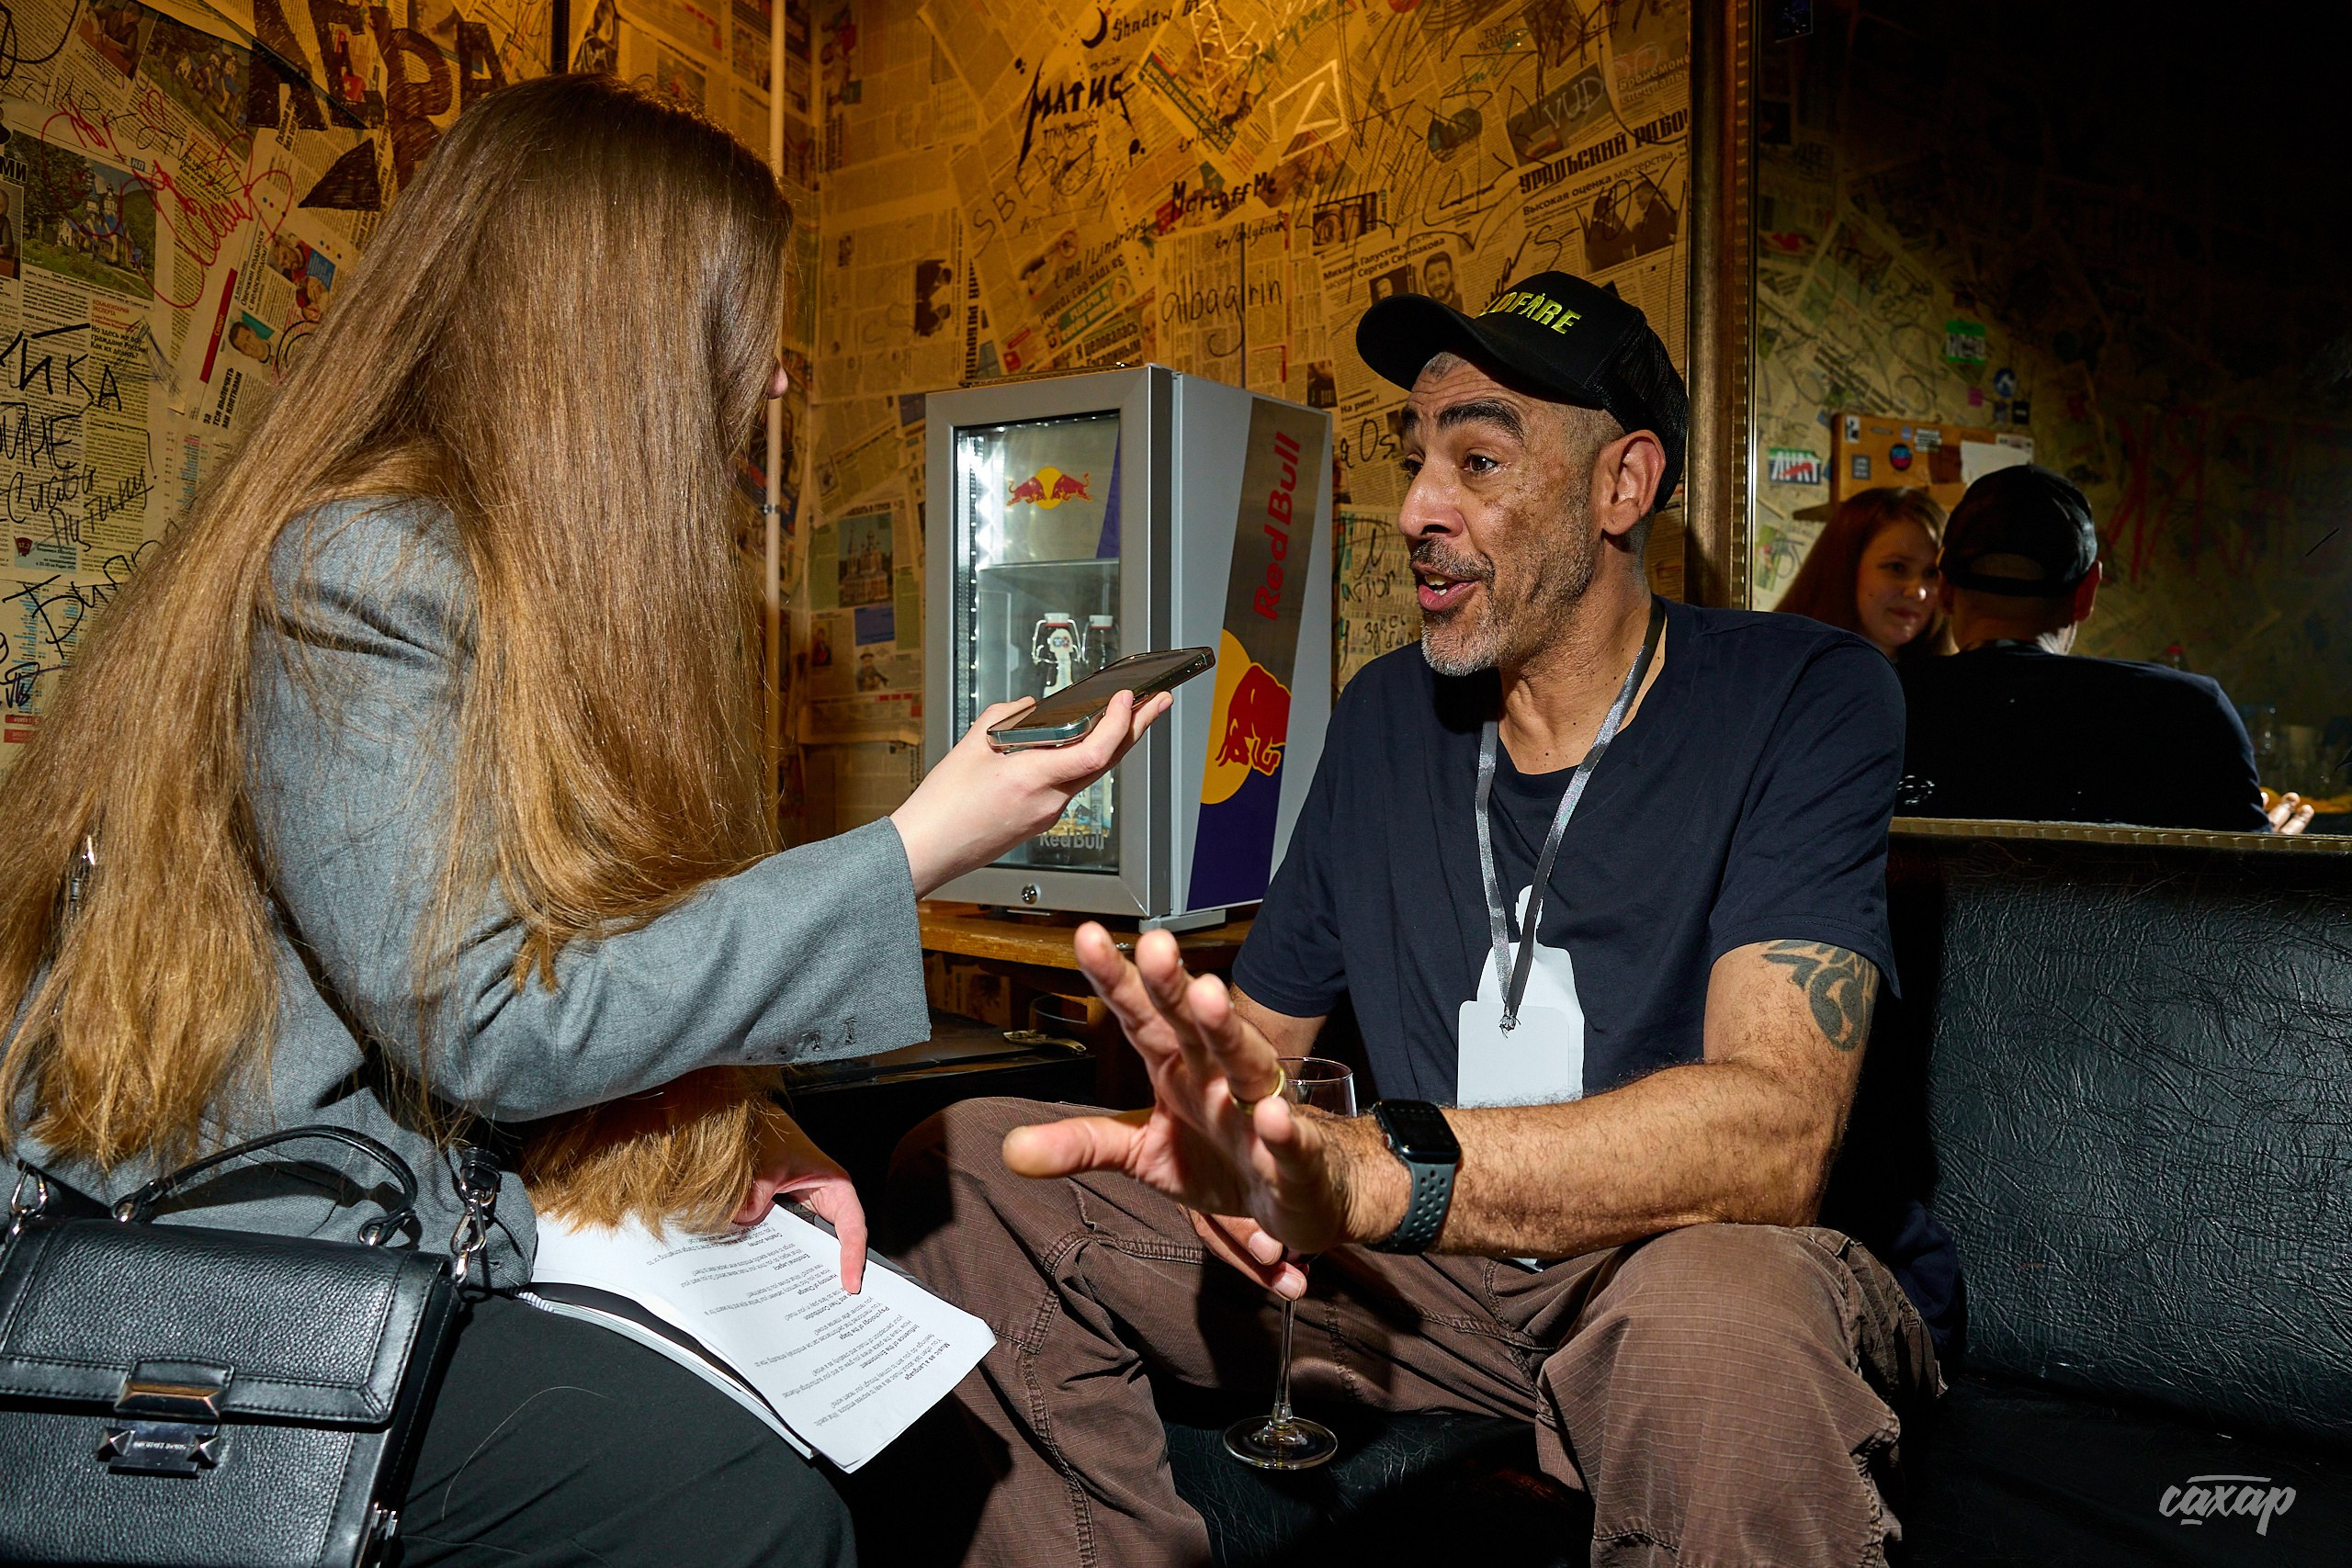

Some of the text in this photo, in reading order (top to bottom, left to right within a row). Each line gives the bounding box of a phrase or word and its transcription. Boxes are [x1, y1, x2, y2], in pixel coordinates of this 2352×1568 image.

[1519, 131, 1628, 195] УРАЛЬСКИЙ
[1522, 190, 1569, 217] Высокая
[1571, 175, 1612, 197] оценка
[1613, 151, 1674, 182] мастерства
[1321, 260, 1359, 280] Михаил
[1359, 243, 1401, 266] Галустян
[1356, 259, 1390, 278] Сергея
[213, 314, 226, 337] Спорт
[91, 333, 124, 347] граждане
[1340, 393, 1380, 415] На ринг!
[1253, 430, 1301, 621] Red Bull
[1039, 830, 1105, 852] Red Bull
[747, 1232, 782, 1247] Creative Journey
[772, 1253, 809, 1270] Emotional Legacy
[817, 1273, 838, 1284] Harmony
[797, 1285, 815, 1294] Change
[838, 1294, 848, 1303] and
[803, 1305, 830, 1319] Contribution
[862, 1306, 889, 1325] Psychology
[839, 1331, 853, 1339] Stage
[897, 1324, 919, 1341] Influence
[933, 1342, 950, 1355] Music
[859, 1349, 887, 1368] Environment
[904, 1362, 926, 1380] Language
